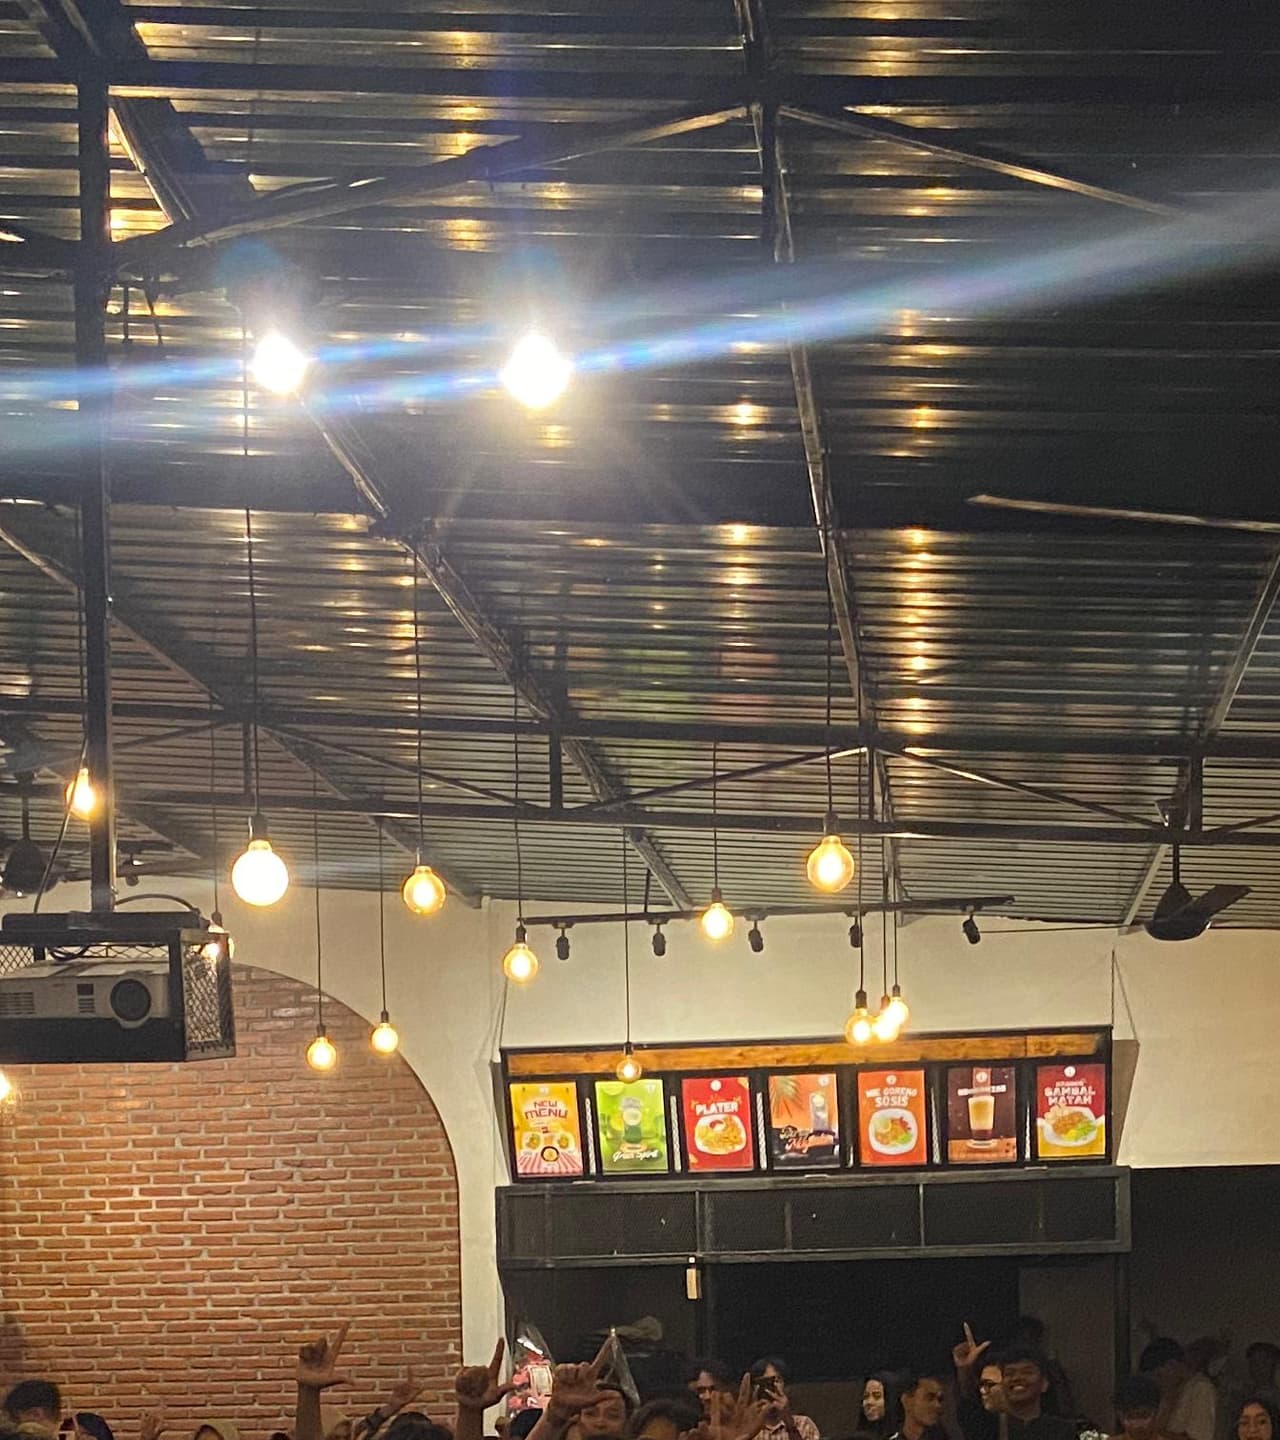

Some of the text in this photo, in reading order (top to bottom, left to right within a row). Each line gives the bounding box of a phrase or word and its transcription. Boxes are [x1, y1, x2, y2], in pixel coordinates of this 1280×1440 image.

[1044, 1086, 1096, 1097] SAMBAL
[534, 1100, 558, 1108] NEW
[875, 1096, 909, 1107] SOSIS
[524, 1108, 568, 1120] MENU
[696, 1101, 739, 1116] PLATER
